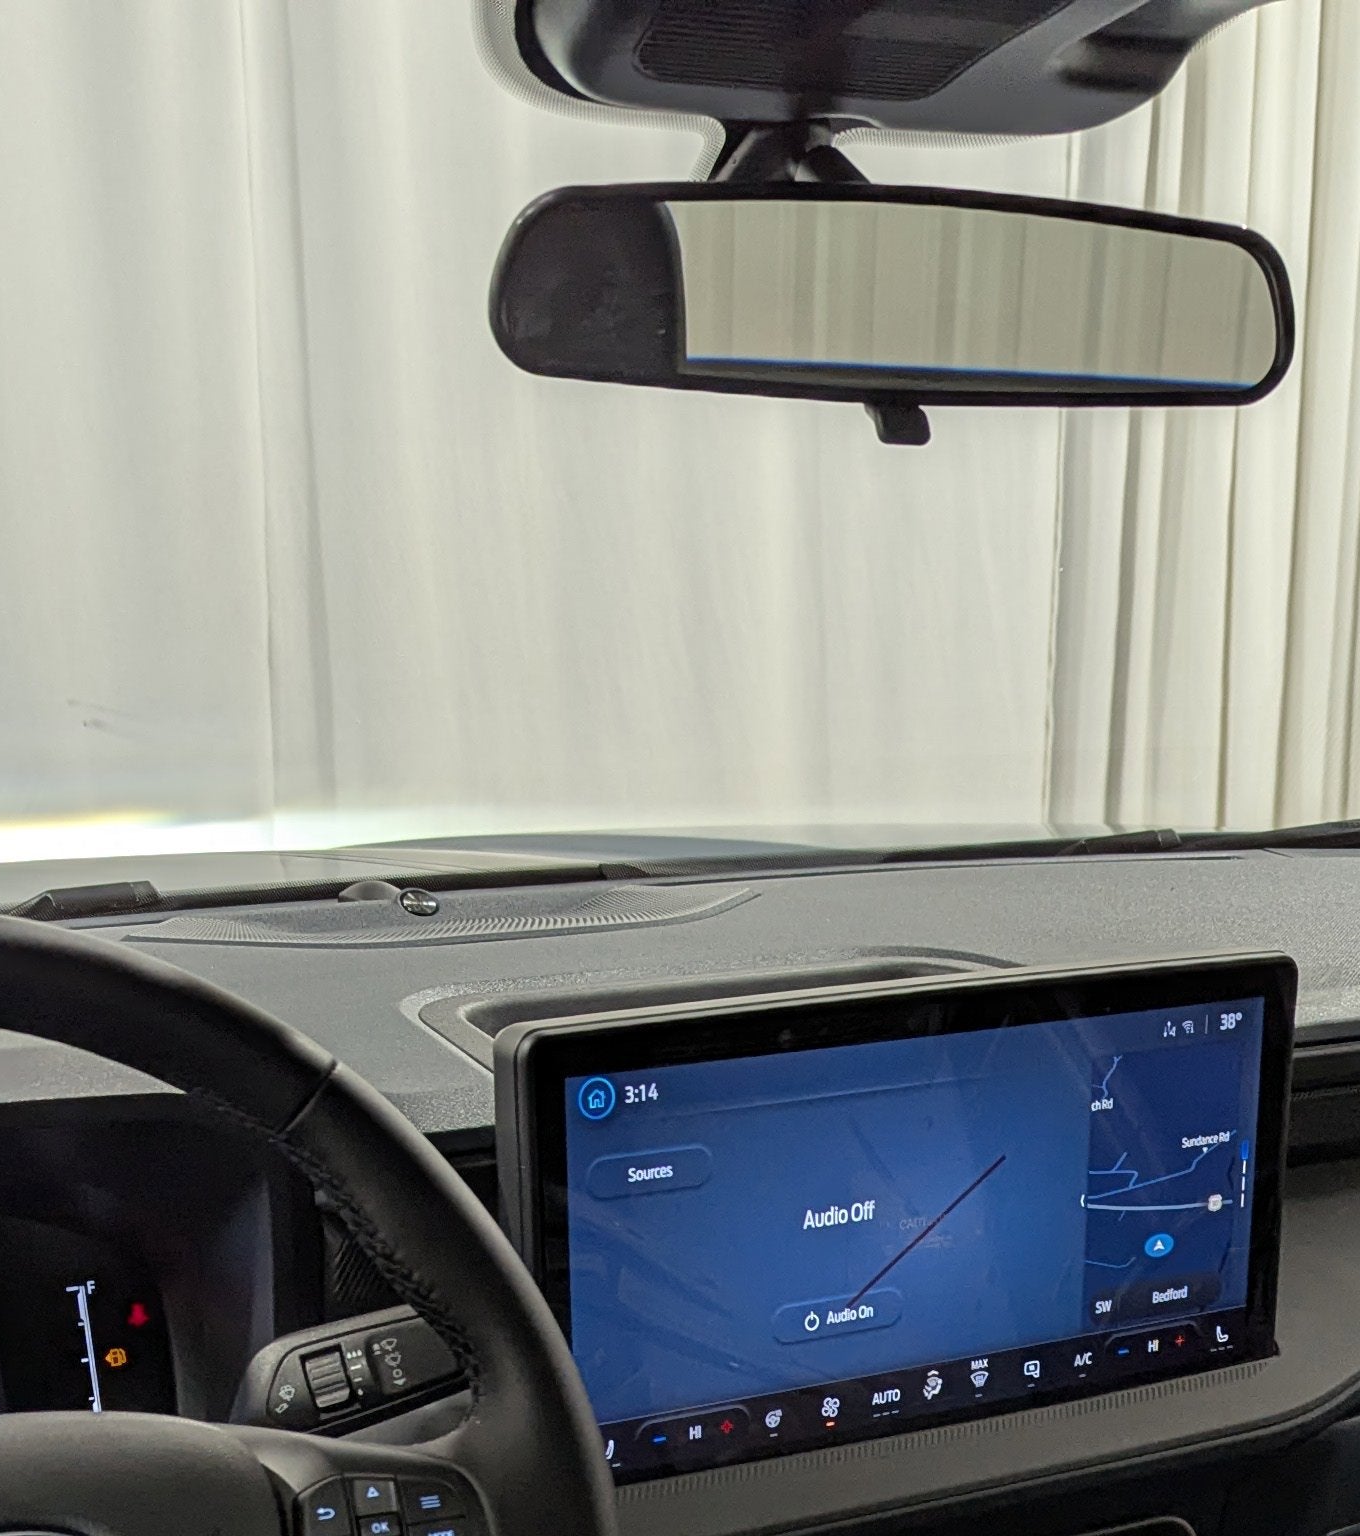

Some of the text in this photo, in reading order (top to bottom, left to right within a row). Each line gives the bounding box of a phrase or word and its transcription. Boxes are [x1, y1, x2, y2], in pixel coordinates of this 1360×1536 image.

[624, 1082, 659, 1104] 3:14
[1102, 1098, 1114, 1110] Rd
[1181, 1131, 1230, 1149] Sundance Rd
[627, 1165, 674, 1183] Sources
[803, 1199, 876, 1230] Audio Off
[86, 1280, 96, 1295] F
[1152, 1285, 1189, 1304] Bedford
[826, 1305, 874, 1325] Audio On
[1095, 1300, 1113, 1315] SW
[970, 1358, 989, 1370] MAX
[1073, 1352, 1093, 1367] A/C
[871, 1388, 901, 1406] AUTO
[371, 1521, 390, 1534] OK
